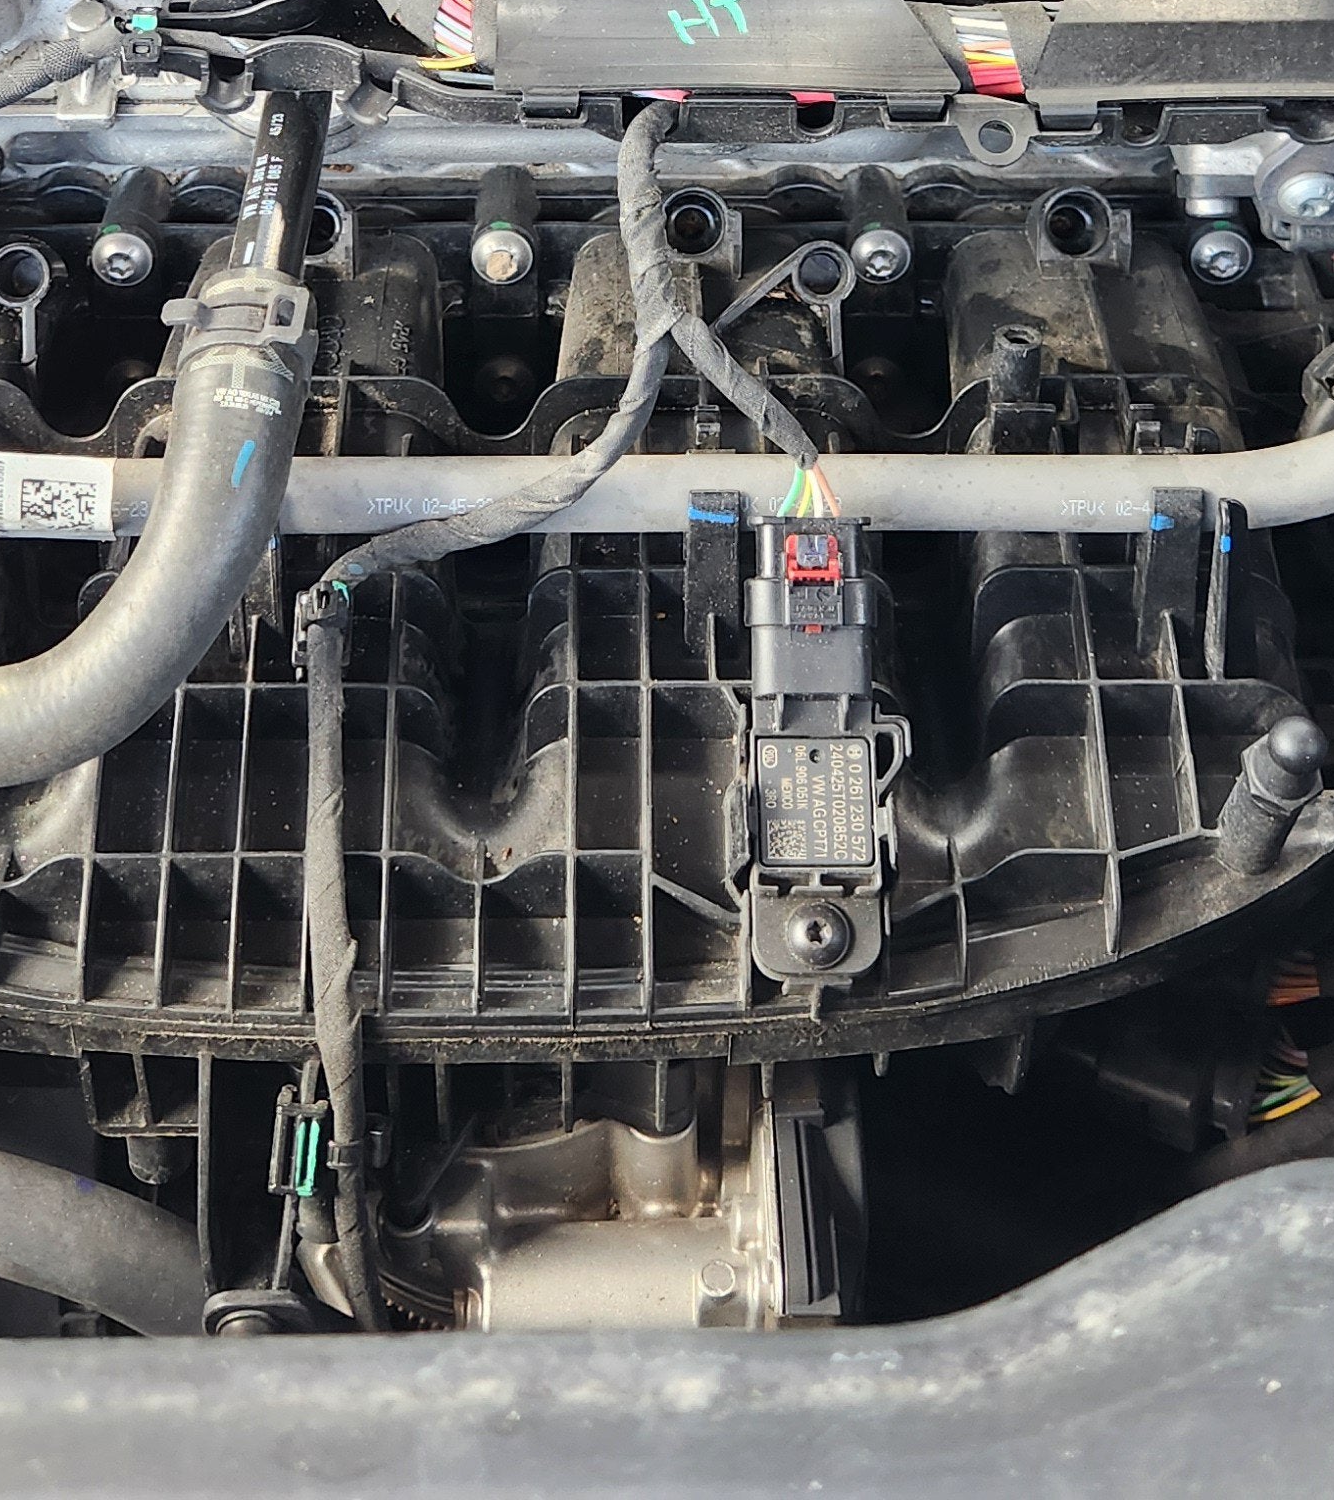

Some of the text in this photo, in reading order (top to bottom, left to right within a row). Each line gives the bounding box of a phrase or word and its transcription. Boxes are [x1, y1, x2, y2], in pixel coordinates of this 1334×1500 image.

[795, 745, 807, 764] 06L
[795, 766, 807, 784] 906
[811, 775, 826, 796] VW
[781, 777, 793, 810] MEXICO
[829, 743, 848, 860] 240425T020852C
[812, 799, 827, 818] AG
[848, 763, 866, 862] 0 261 230 572
